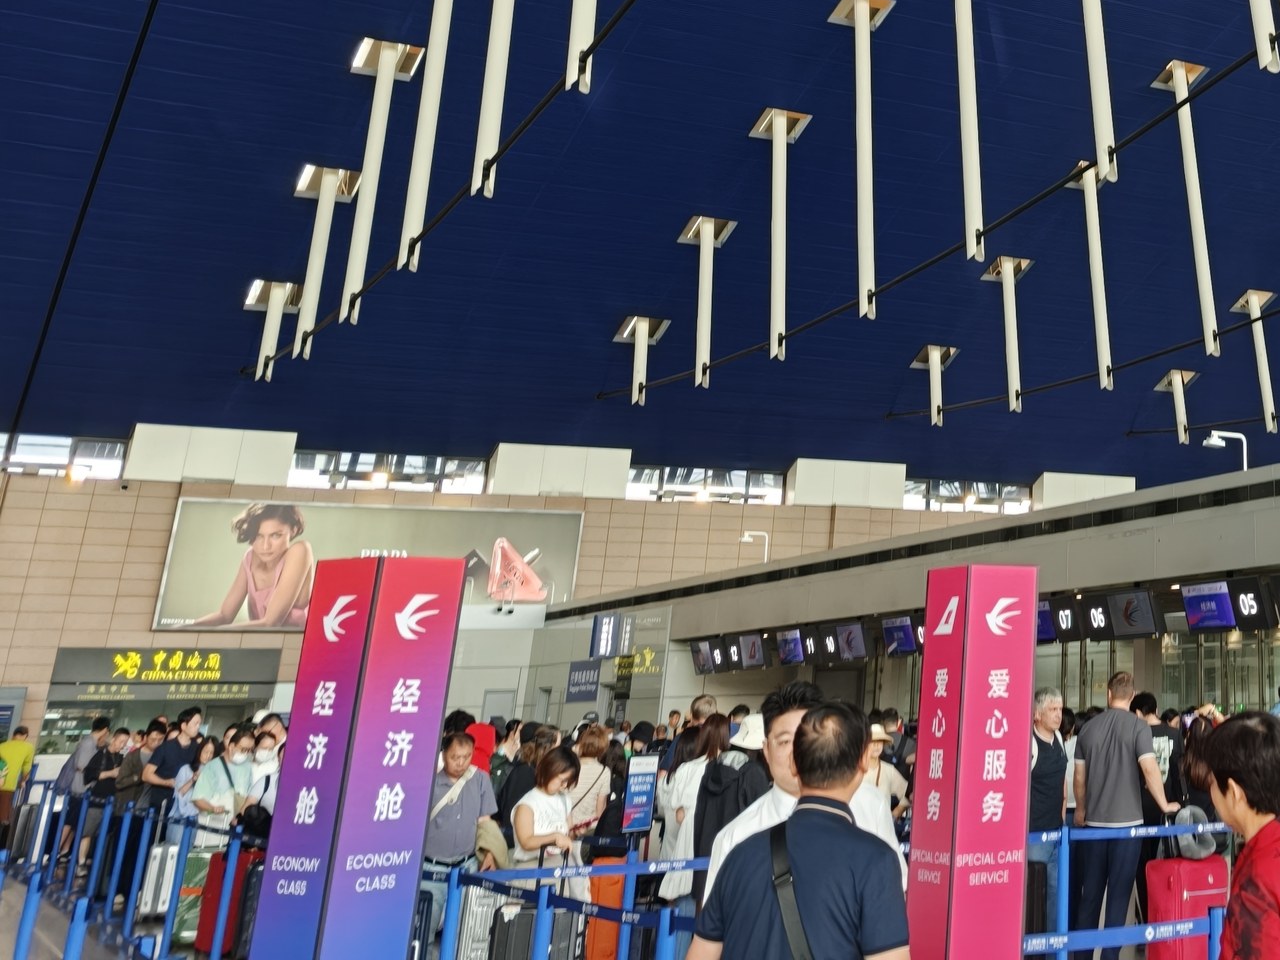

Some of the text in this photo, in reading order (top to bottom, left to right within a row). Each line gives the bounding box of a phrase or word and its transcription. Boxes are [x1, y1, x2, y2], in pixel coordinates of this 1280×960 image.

[1239, 593, 1258, 616] 05
[1058, 609, 1071, 630] 07
[1090, 608, 1105, 629] 06
[805, 637, 815, 655] 11
[141, 670, 221, 680] CHINA CUSTOMS
[294, 681, 337, 825] 经济舱
[374, 678, 421, 822] 经济舱
[927, 668, 949, 822] 爱心服务
[982, 668, 1010, 823] 爱心服务
[272, 856, 321, 873] ECONOMY
[346, 850, 413, 871] ECONOMY
[911, 848, 951, 866] SPECIAL CARE
[956, 849, 1025, 868] SPECIAL CARE
[277, 879, 307, 896] CLASS
[355, 873, 396, 893] CLASS
[969, 869, 1010, 886] SERVICE
